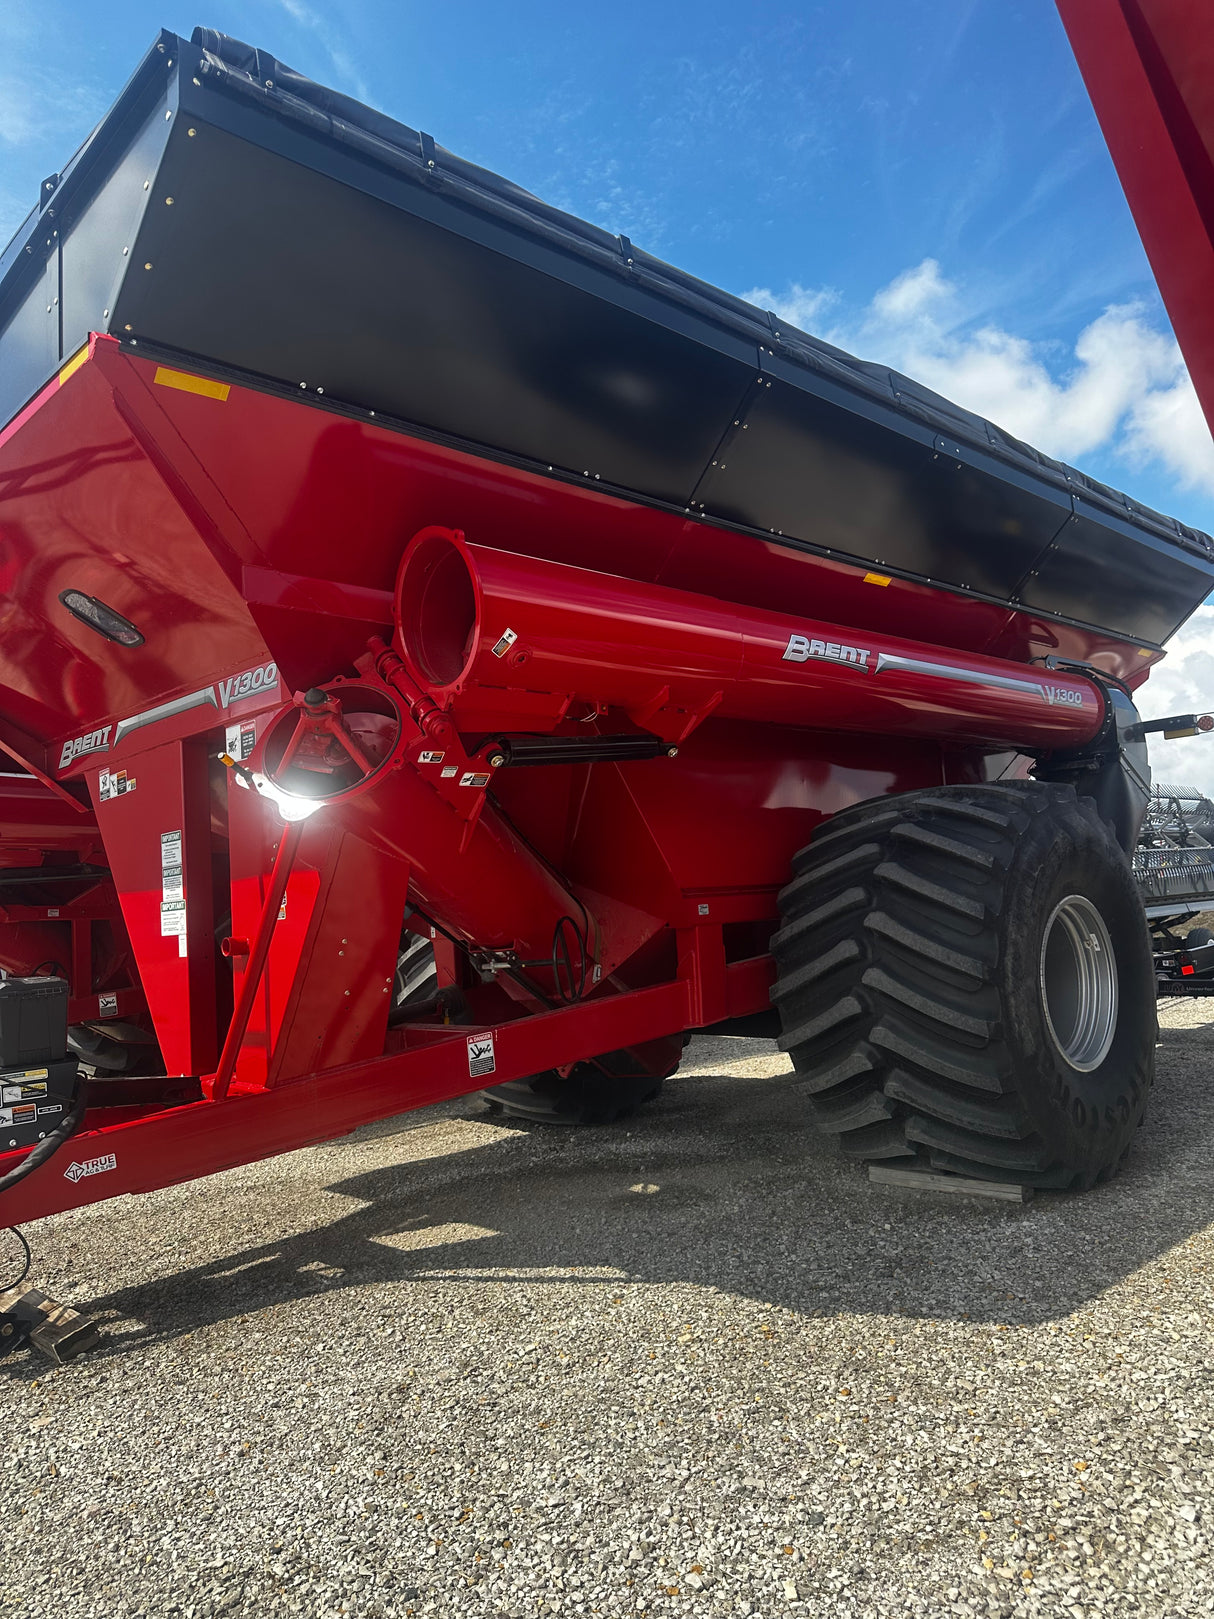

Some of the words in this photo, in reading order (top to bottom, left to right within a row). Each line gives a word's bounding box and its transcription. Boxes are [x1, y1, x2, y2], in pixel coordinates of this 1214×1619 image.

[782, 634, 871, 672] BRENT
[1045, 685, 1083, 707] V1300
[58, 725, 112, 769] BRENT
[218, 662, 278, 709] V1300
[162, 902, 184, 911] IMPORTANT
[84, 1155, 114, 1169] TRUE
